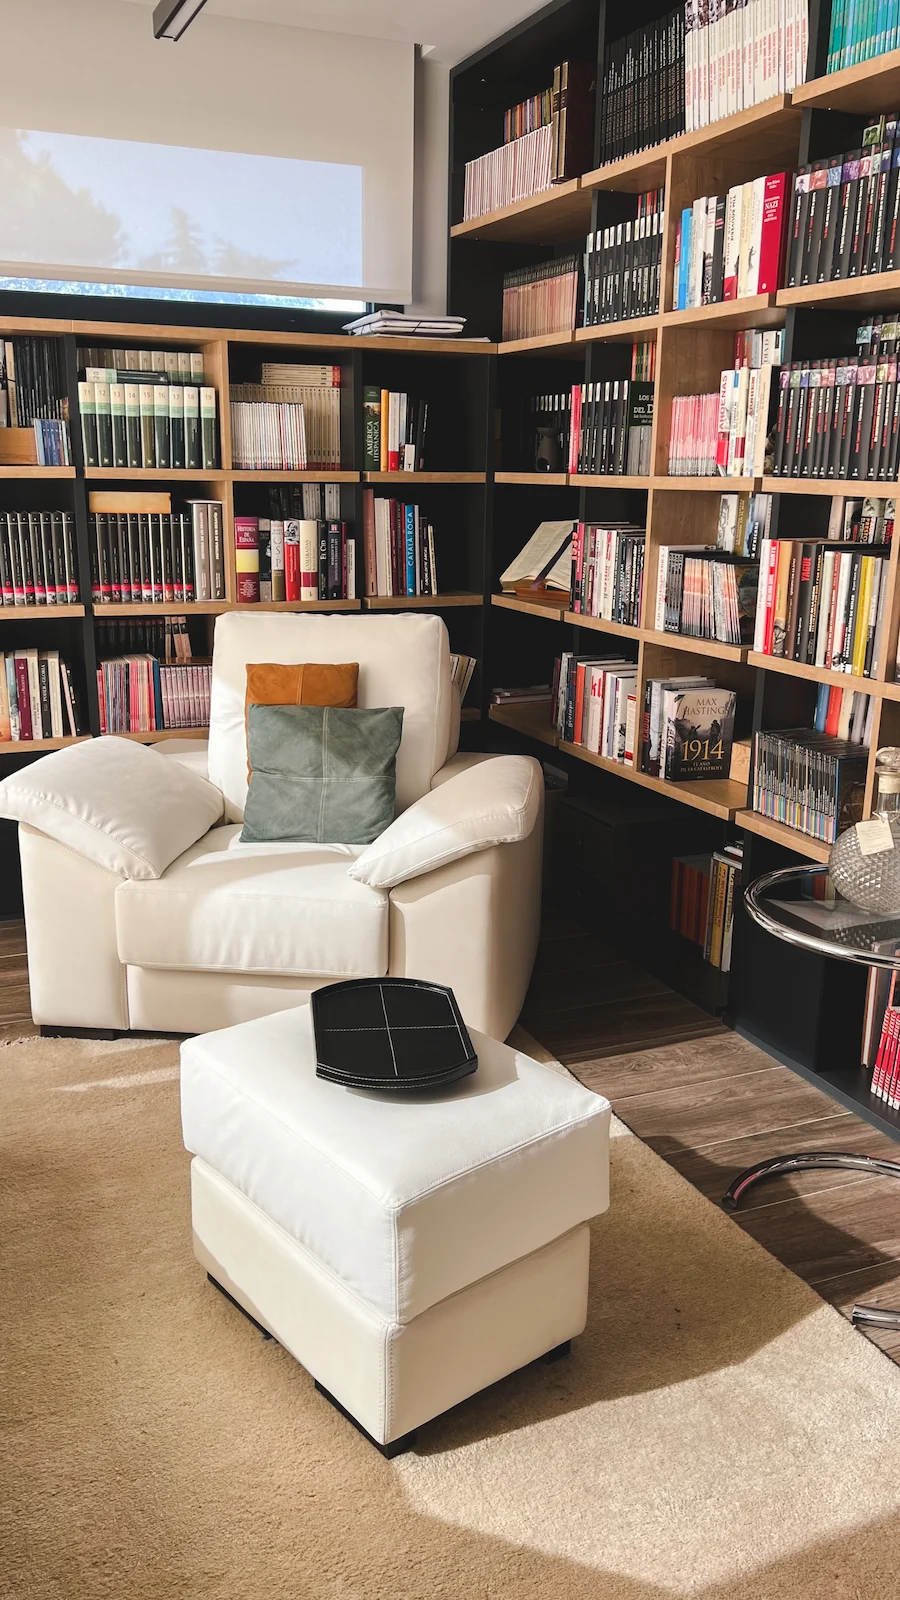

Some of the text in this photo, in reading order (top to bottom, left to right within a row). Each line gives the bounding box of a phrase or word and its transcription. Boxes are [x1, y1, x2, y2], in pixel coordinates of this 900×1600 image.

[765, 200, 779, 210] NAZI
[93, 371, 100, 379] 20
[719, 375, 728, 430] ARDENAS
[633, 406, 646, 414] DEL
[366, 420, 374, 456] AMÉRICA
[696, 698, 718, 706] MAX
[681, 739, 725, 761] 1914
[721, 868, 726, 879] 3
